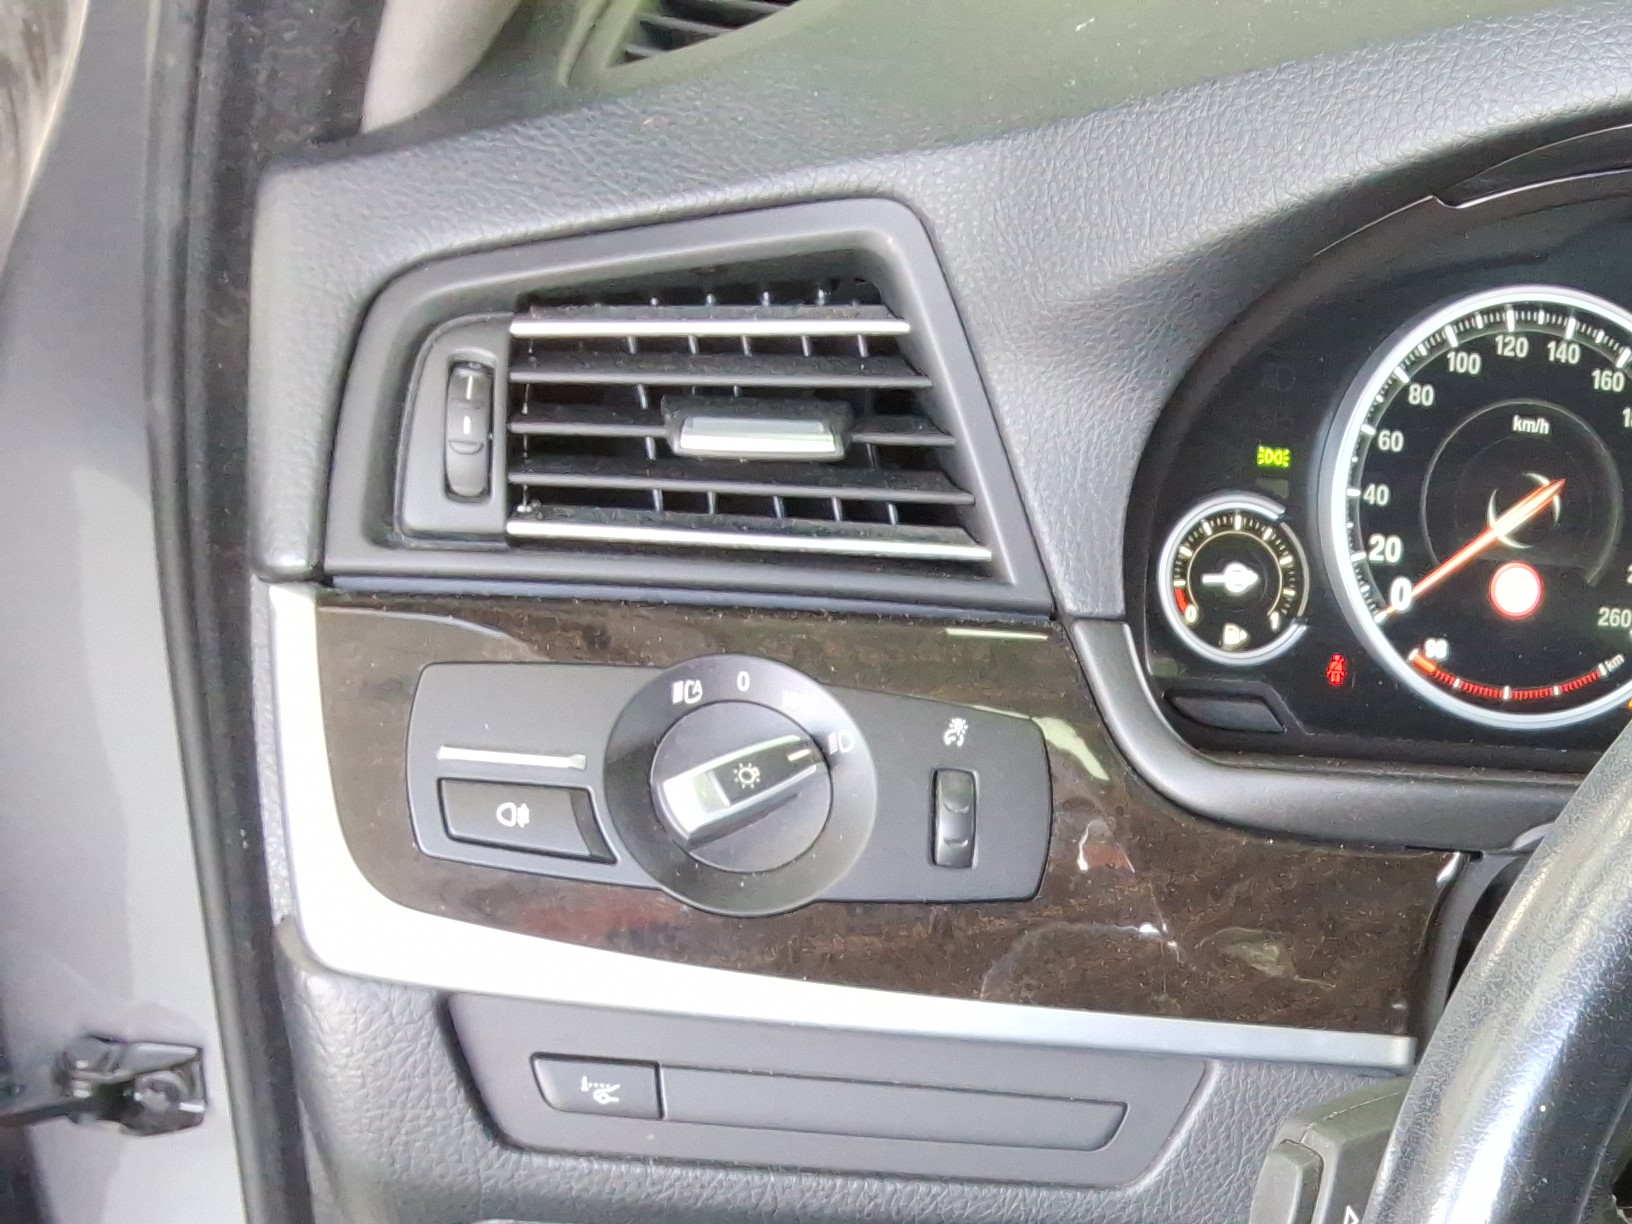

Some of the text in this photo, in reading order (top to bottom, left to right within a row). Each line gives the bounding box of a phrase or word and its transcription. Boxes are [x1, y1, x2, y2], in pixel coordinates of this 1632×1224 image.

[1494, 334, 1529, 358] 120
[1547, 340, 1580, 365] 140
[1446, 351, 1481, 375] 100
[1591, 367, 1625, 392] 160
[1408, 383, 1434, 406] 80
[1512, 414, 1550, 435] km/h
[1377, 429, 1404, 452] 60
[1362, 483, 1390, 506] 40
[1368, 532, 1403, 563] 20
[1389, 575, 1413, 612] 0
[1597, 607, 1632, 629] 260
[1604, 654, 1626, 673] km
